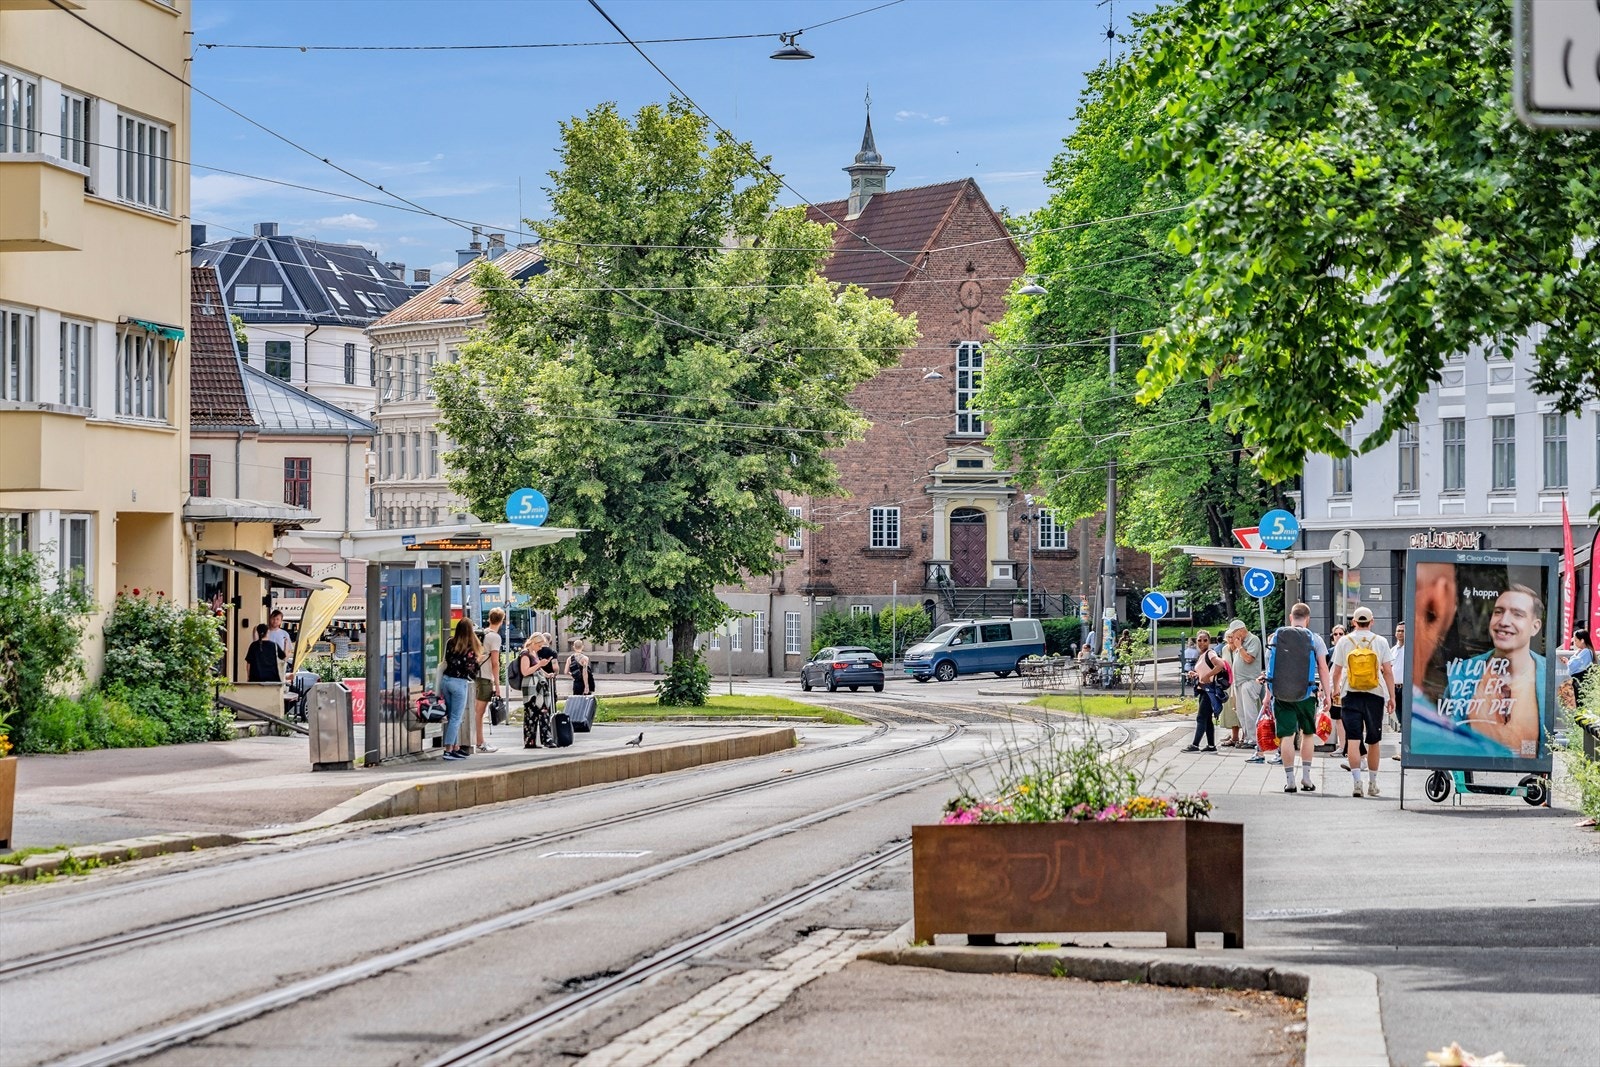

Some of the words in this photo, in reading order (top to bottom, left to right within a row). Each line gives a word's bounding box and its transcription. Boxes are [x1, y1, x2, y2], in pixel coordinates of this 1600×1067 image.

[520, 495, 533, 514] 5
[1272, 517, 1286, 535] 5
[1483, 555, 1509, 563] Channel
[1472, 587, 1499, 600] happn
[1451, 678, 1483, 697] DET
[1485, 678, 1506, 695] ER
[1437, 698, 1486, 717] VERDT
[1489, 698, 1517, 716] DET
